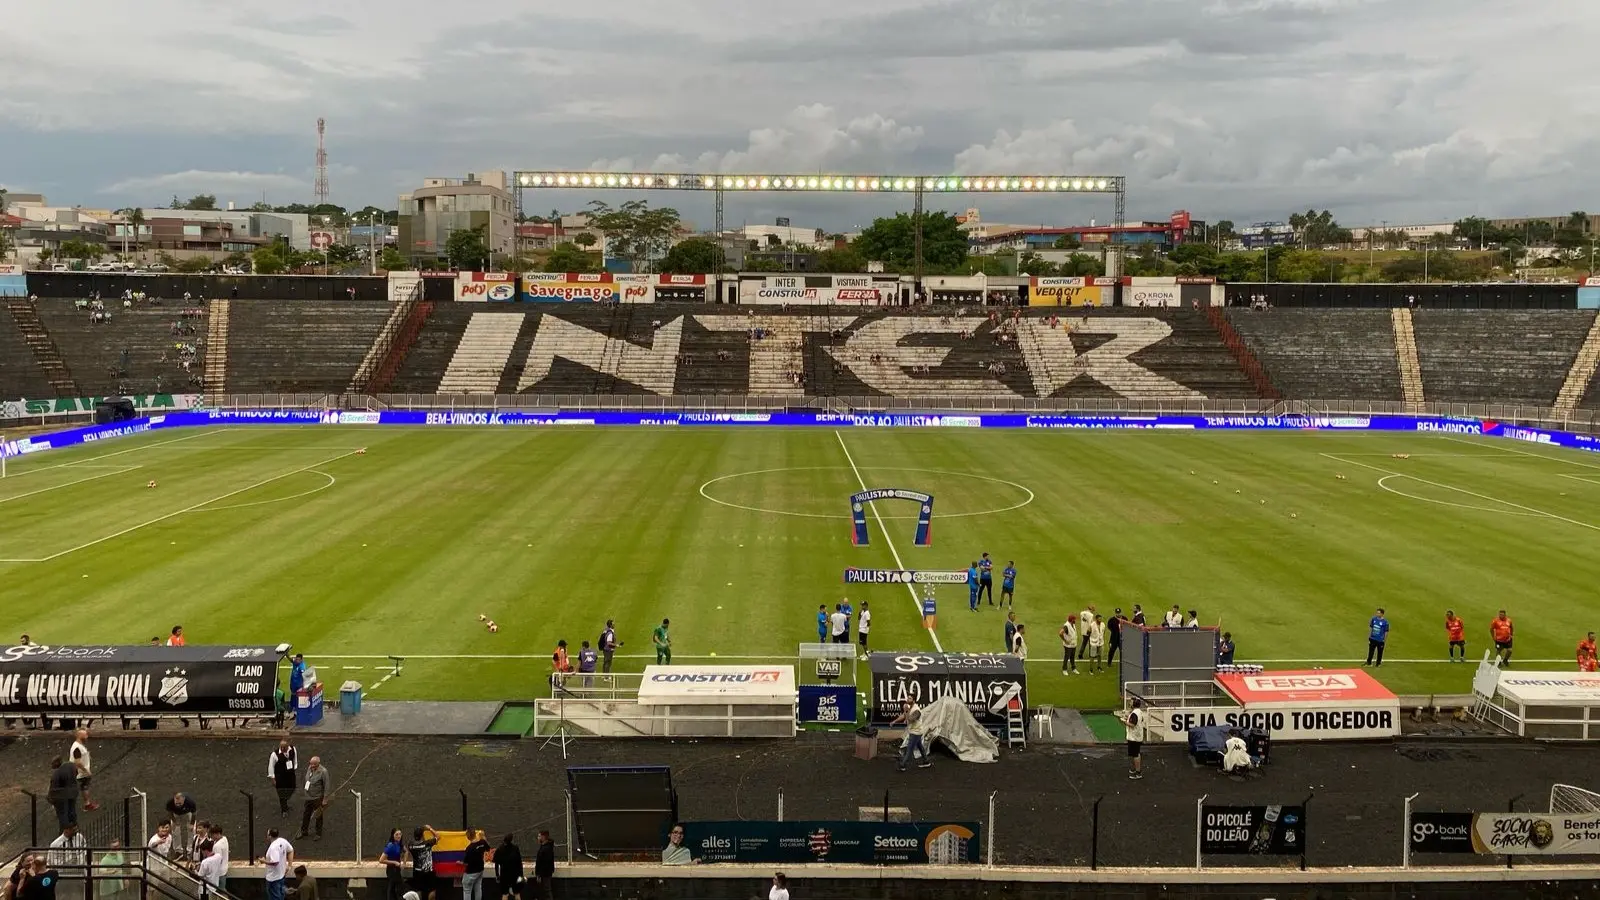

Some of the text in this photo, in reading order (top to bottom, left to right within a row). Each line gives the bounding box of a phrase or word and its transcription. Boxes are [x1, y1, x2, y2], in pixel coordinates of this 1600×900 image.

[775, 278, 796, 287] INTER
[836, 278, 868, 287] VISITANTE
[461, 284, 486, 297] poty
[530, 283, 612, 300] Savegnago
[625, 285, 648, 298] poty
[1035, 287, 1082, 297] VEDACIT
[434, 311, 1209, 399] INTER
[426, 413, 488, 424] BEM-VINDOS
[923, 571, 950, 580] Sicredi
[950, 572, 966, 580] 2025
[234, 665, 263, 676] PLANO
[819, 662, 839, 671] VAR
[894, 655, 1006, 673] go.bank
[27, 673, 101, 707] NENHUM
[106, 673, 153, 707] RIVAL
[236, 682, 259, 693] OURO
[879, 676, 986, 702] LEÃO MANIA
[1291, 711, 1392, 731] TORCEDOR
[1207, 811, 1252, 826] O PICOLÉ
[1206, 827, 1249, 841] DO LEÃO
[1412, 823, 1468, 842] go.bank
[1567, 832, 1582, 841] os
[702, 835, 731, 850] alles
[874, 835, 918, 847] Settore
[1491, 833, 1531, 848] GARRA
